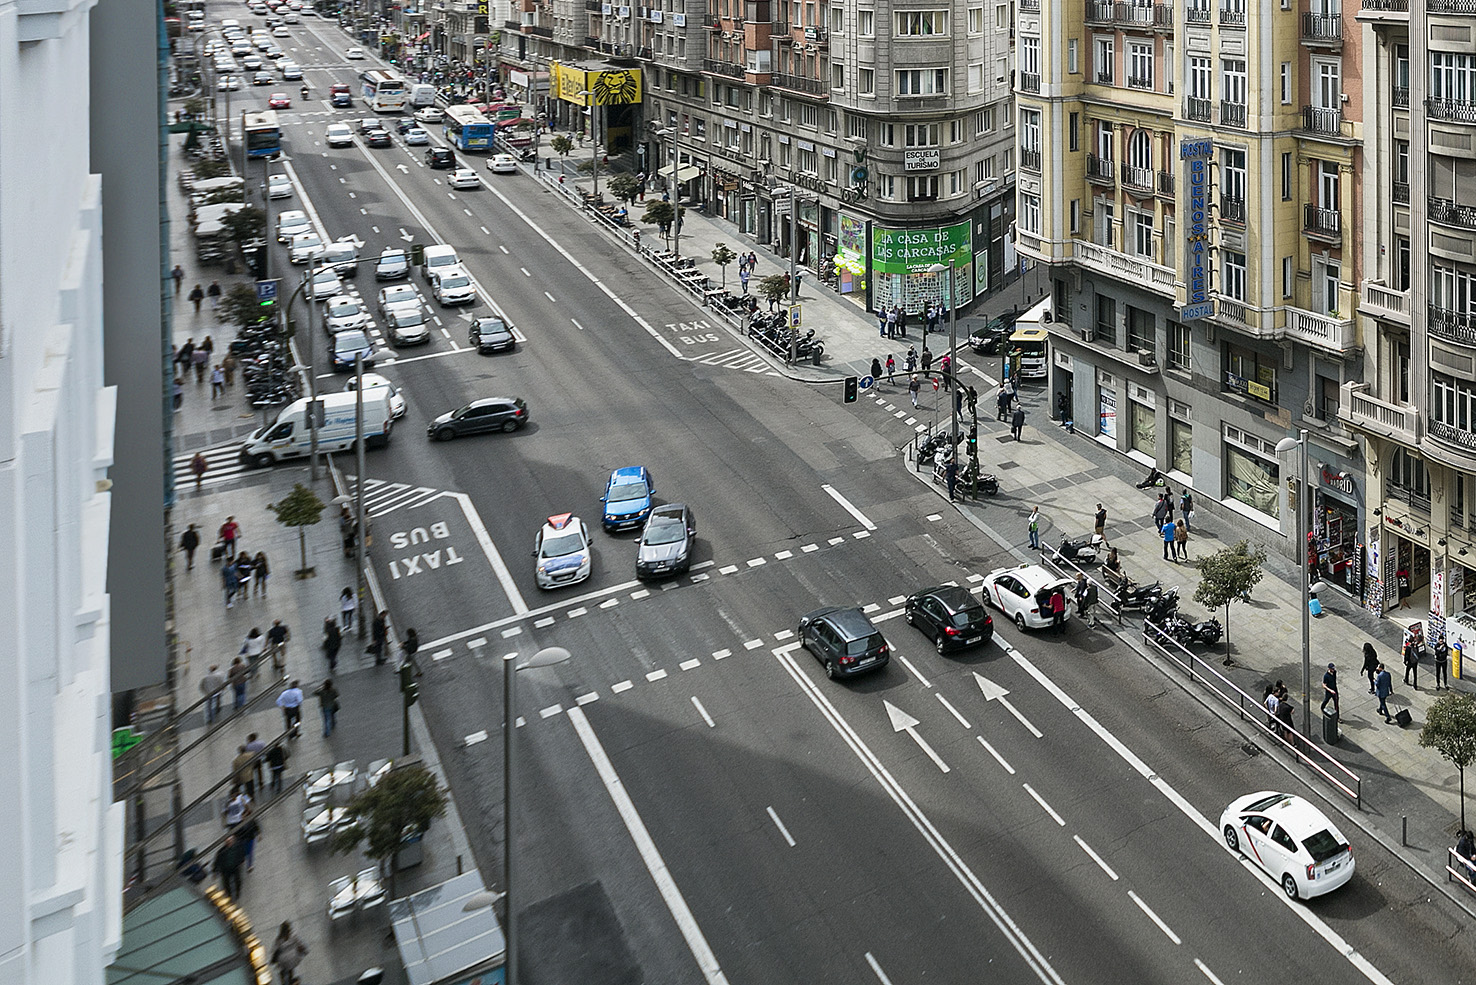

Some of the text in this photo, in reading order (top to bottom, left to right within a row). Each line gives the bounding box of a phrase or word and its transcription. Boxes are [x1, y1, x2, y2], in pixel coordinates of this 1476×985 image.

[906, 150, 939, 159] ESCUELA
[1182, 140, 1213, 158] HOSTAL
[907, 161, 939, 169] TURISMO
[881, 231, 949, 244] LA CASA DE
[1191, 160, 1205, 304] BUENOS AIRES
[877, 244, 956, 258] LAS CARCASAS
[1182, 304, 1213, 319] HOSTAL
[665, 320, 711, 333] TAXI
[680, 333, 720, 345] BUS
[390, 521, 450, 549] BUS
[388, 546, 464, 580] TAXI
